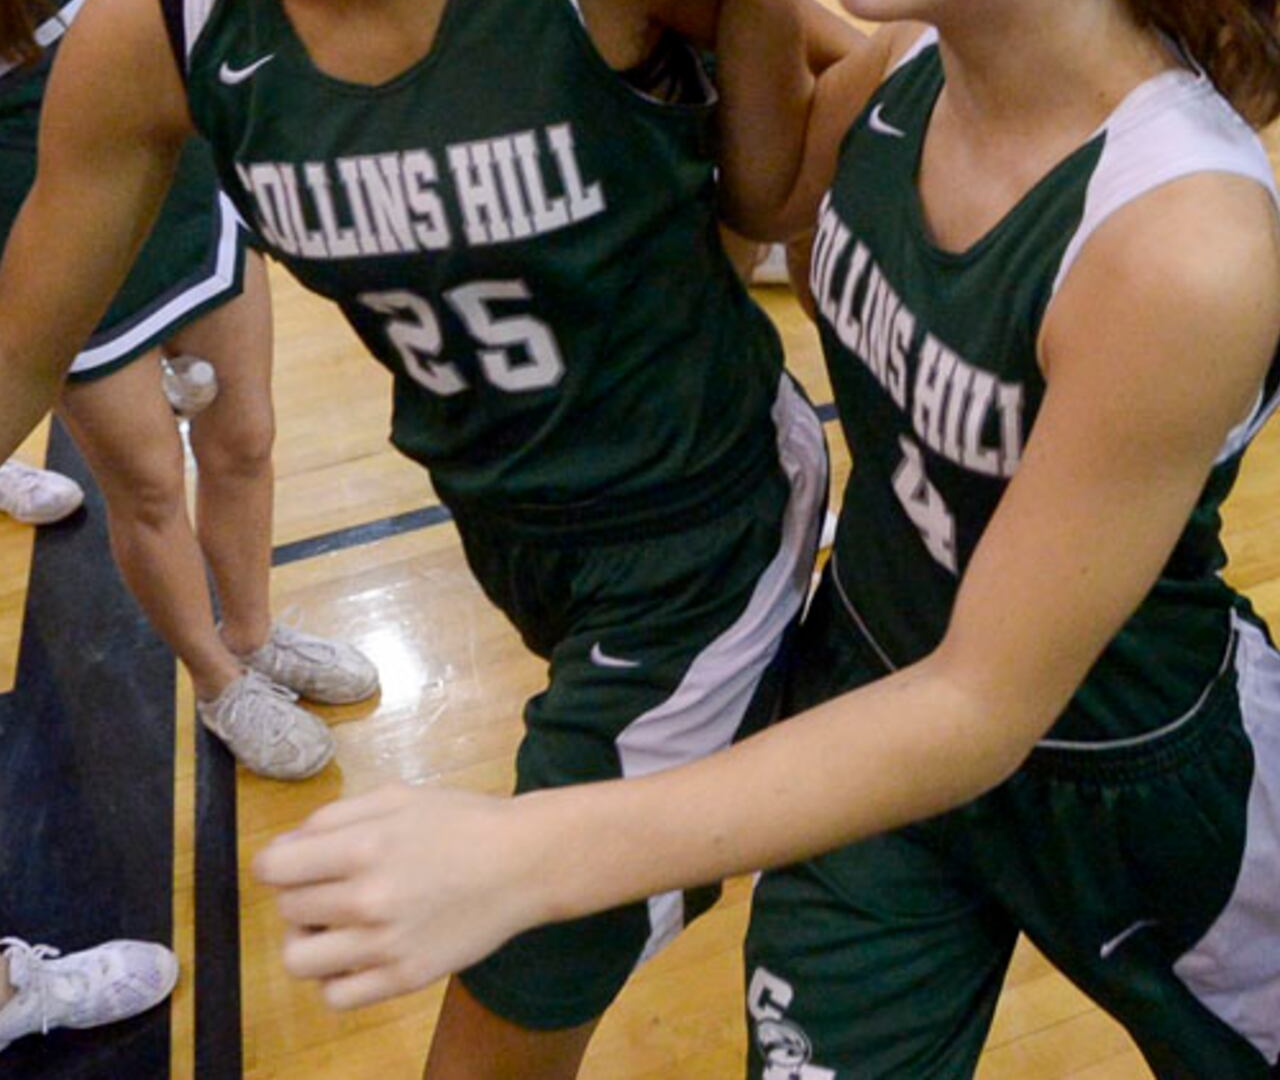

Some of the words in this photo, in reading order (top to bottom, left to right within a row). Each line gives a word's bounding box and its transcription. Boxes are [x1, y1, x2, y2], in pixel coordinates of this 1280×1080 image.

[445, 122, 608, 247] HILL
[357, 278, 567, 397] 25
[891, 433, 960, 578] 4
